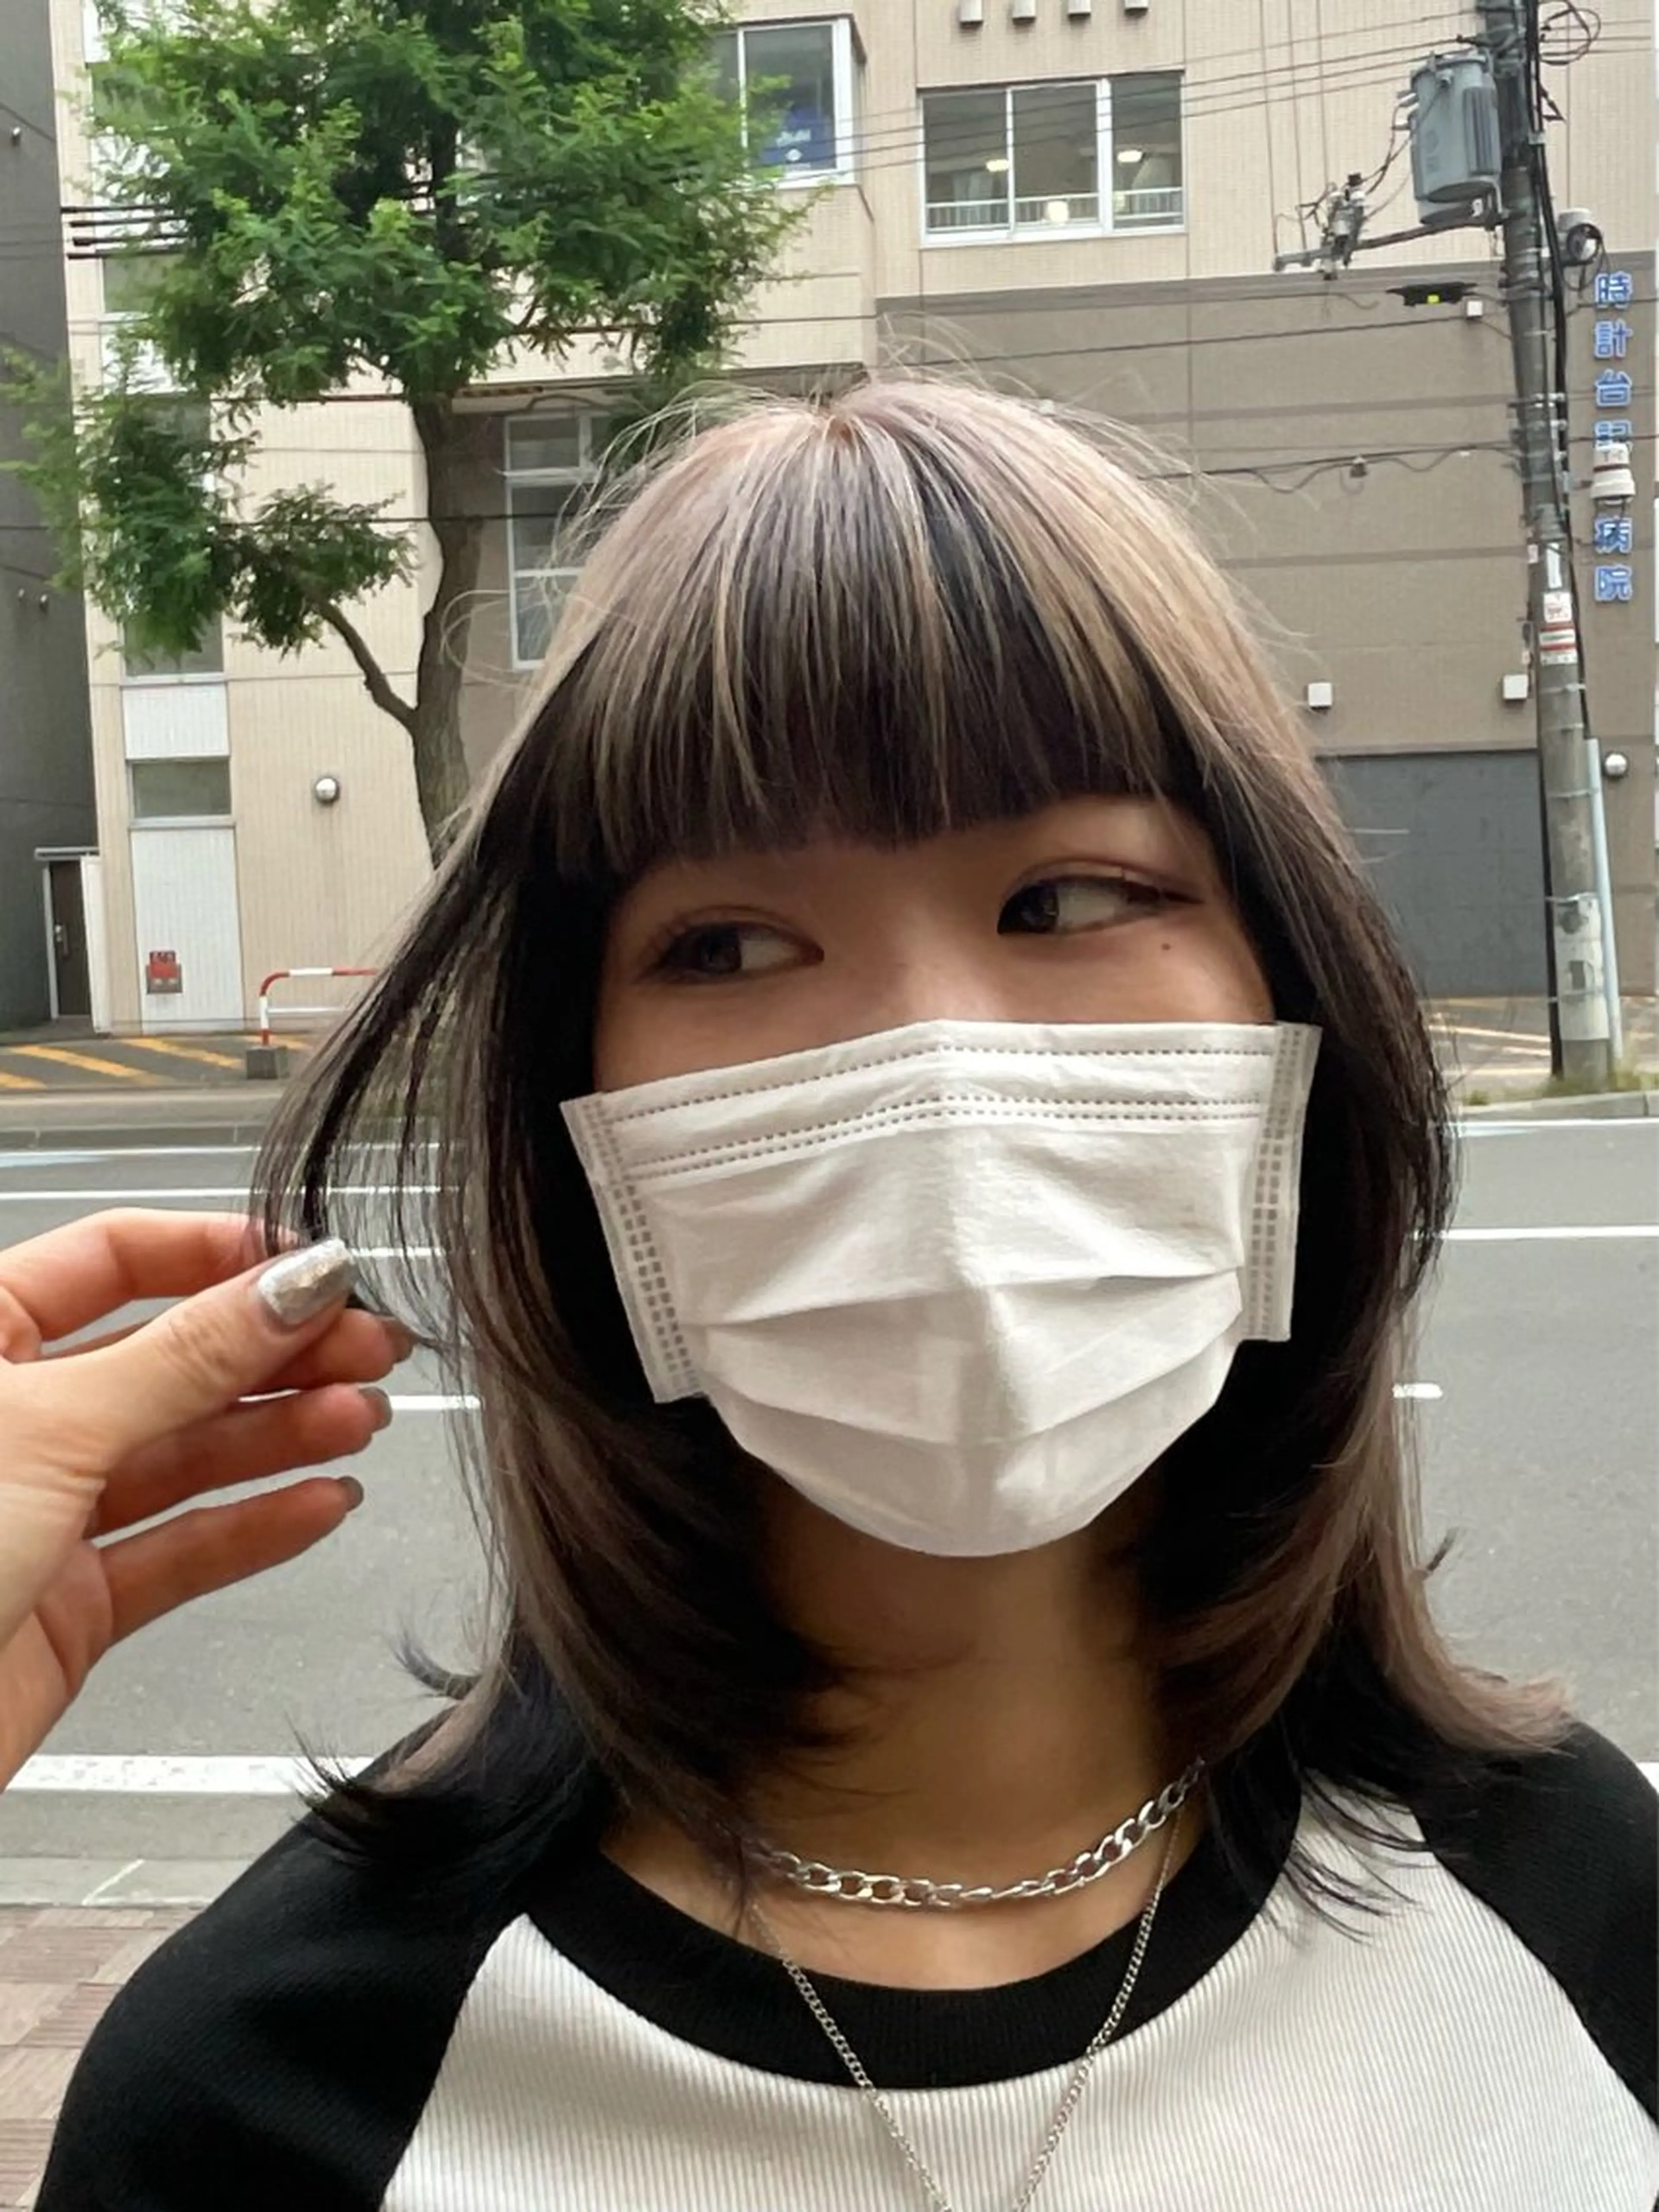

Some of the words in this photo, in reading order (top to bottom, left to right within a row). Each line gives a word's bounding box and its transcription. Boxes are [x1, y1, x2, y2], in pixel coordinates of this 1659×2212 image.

[1594, 270, 1634, 601] 時計台記病院
